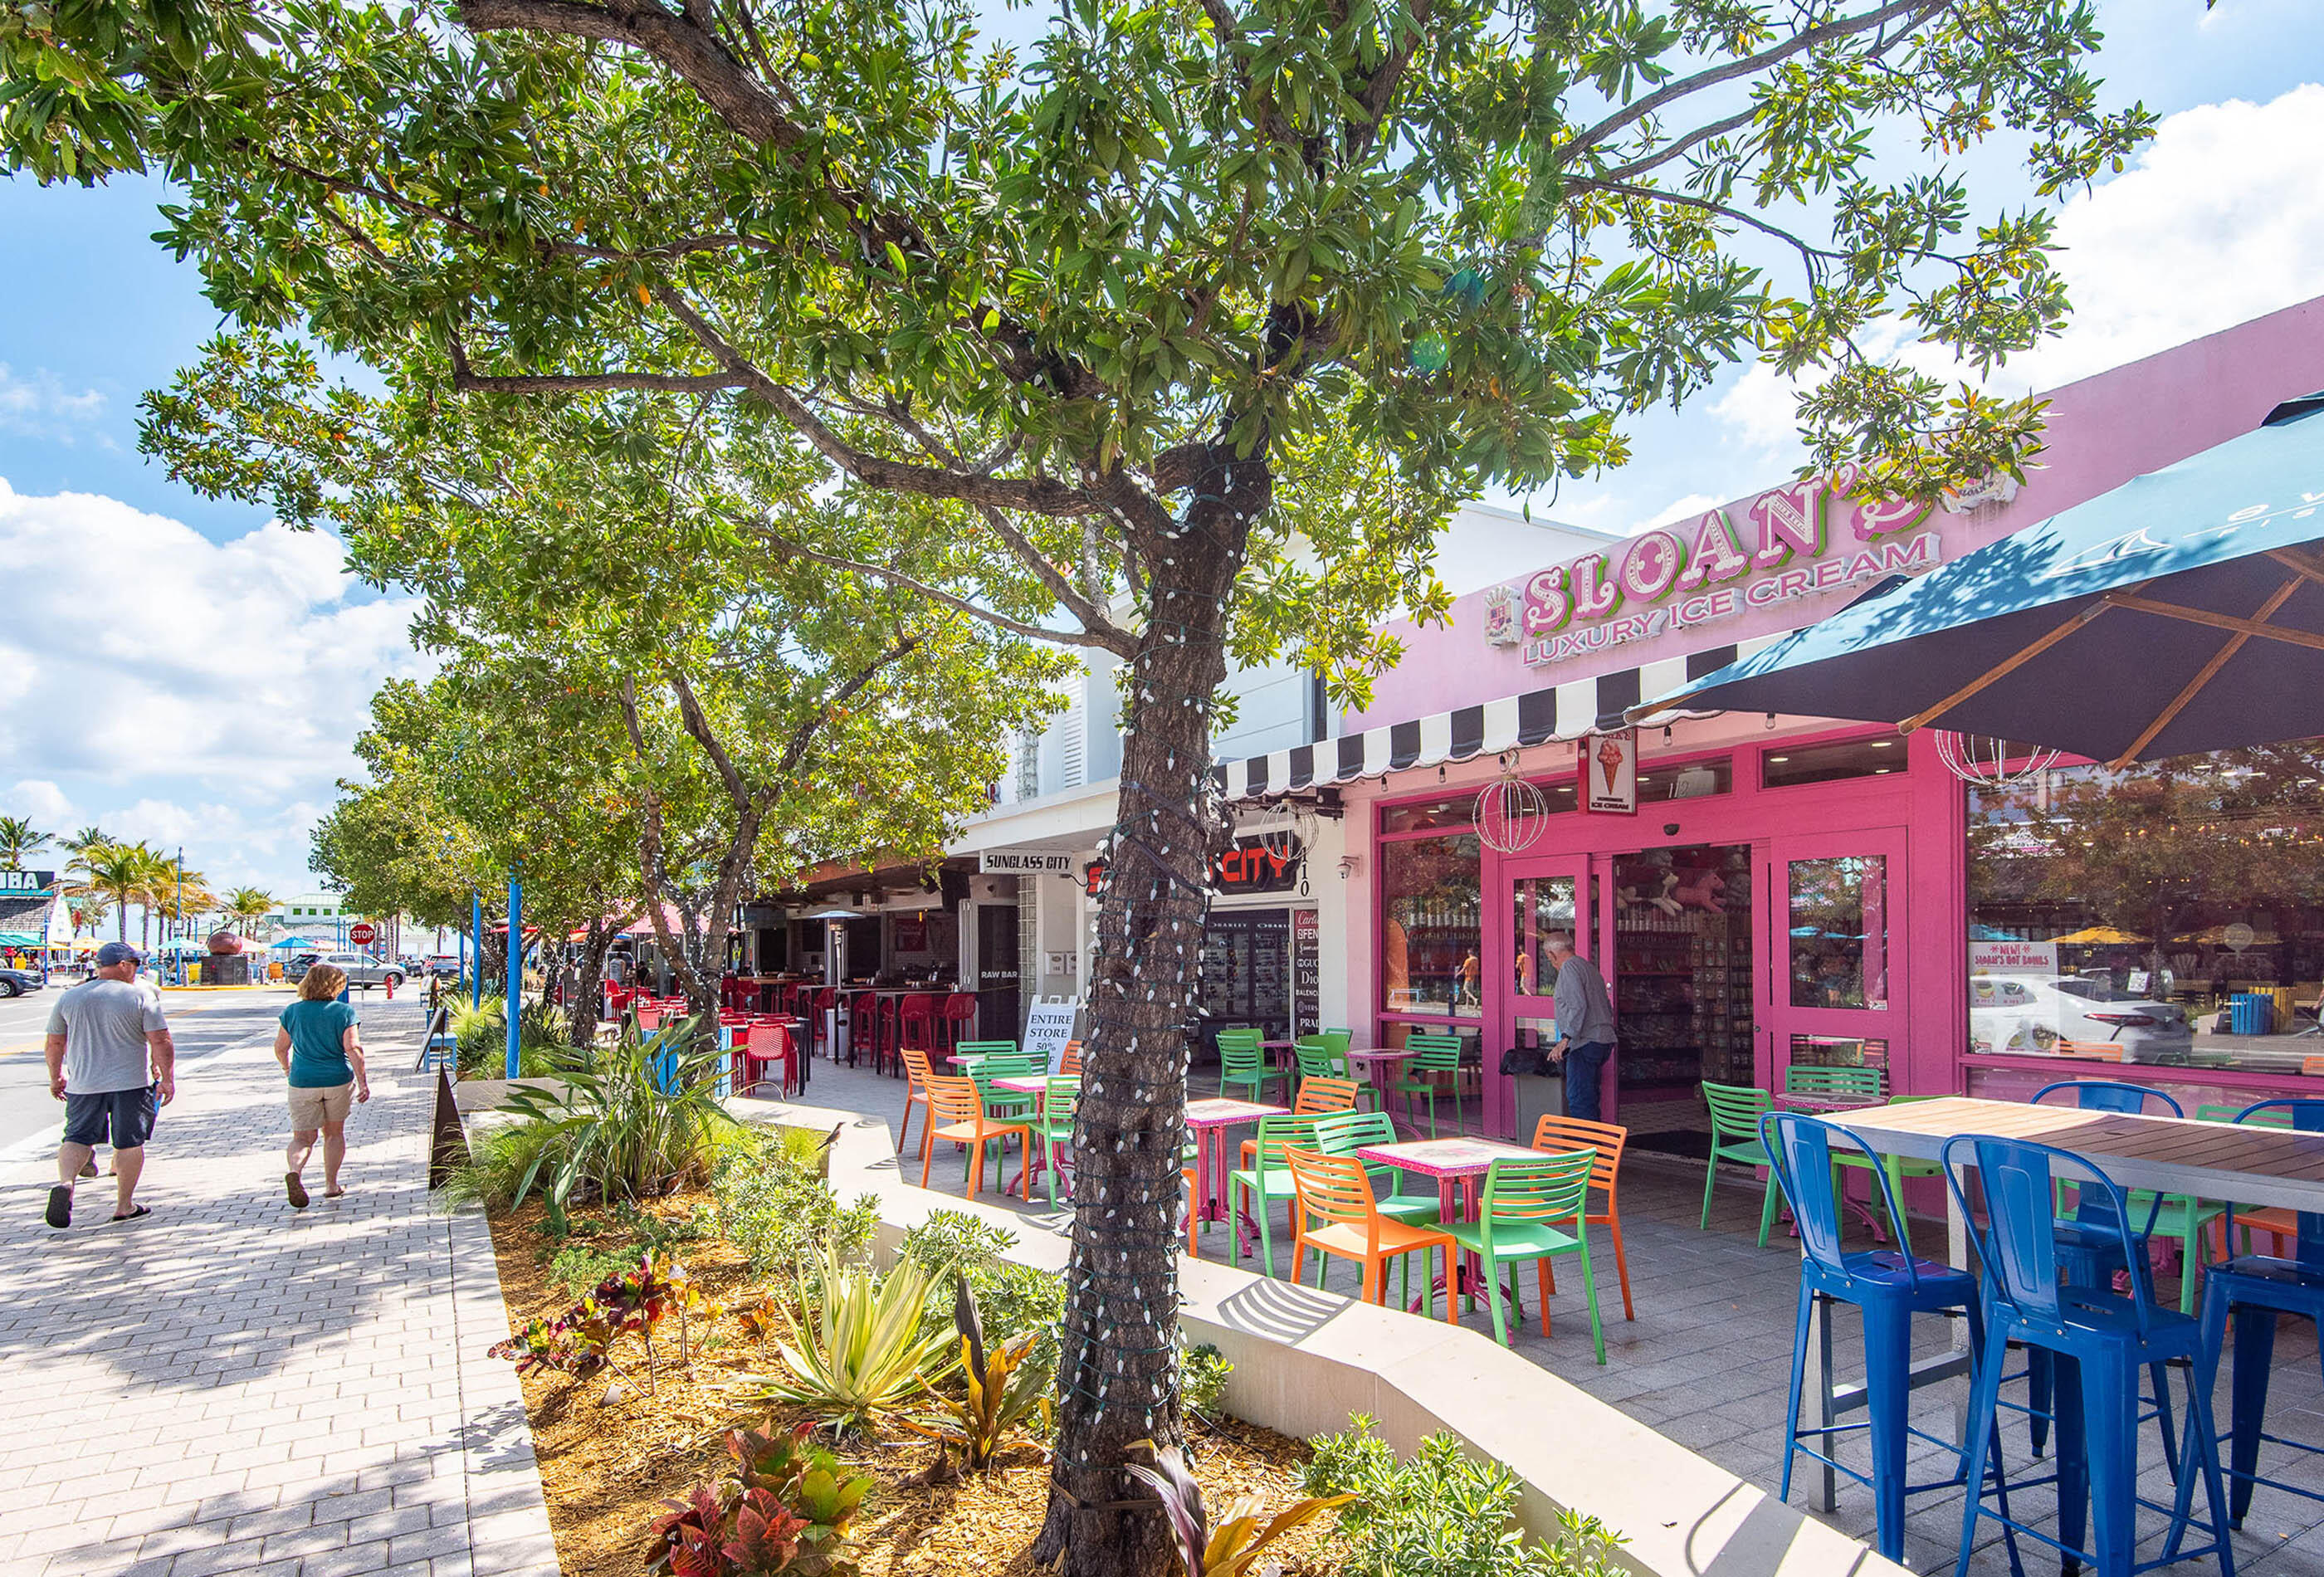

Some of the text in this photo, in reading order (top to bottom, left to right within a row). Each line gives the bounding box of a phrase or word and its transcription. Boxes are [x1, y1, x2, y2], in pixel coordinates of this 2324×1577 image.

[1521, 531, 1934, 666] LUXURY ICE CREAM
[986, 854, 1072, 870] SUNGLASS CITY
[1222, 843, 1289, 882] CITY
[1301, 847, 1310, 896] 110
[351, 930, 374, 940] STOP
[981, 970, 1000, 979] RAW
[1031, 1014, 1072, 1024] ENTIRE
[1029, 1028, 1068, 1038] STORE
[1035, 1042, 1057, 1052] 50%
